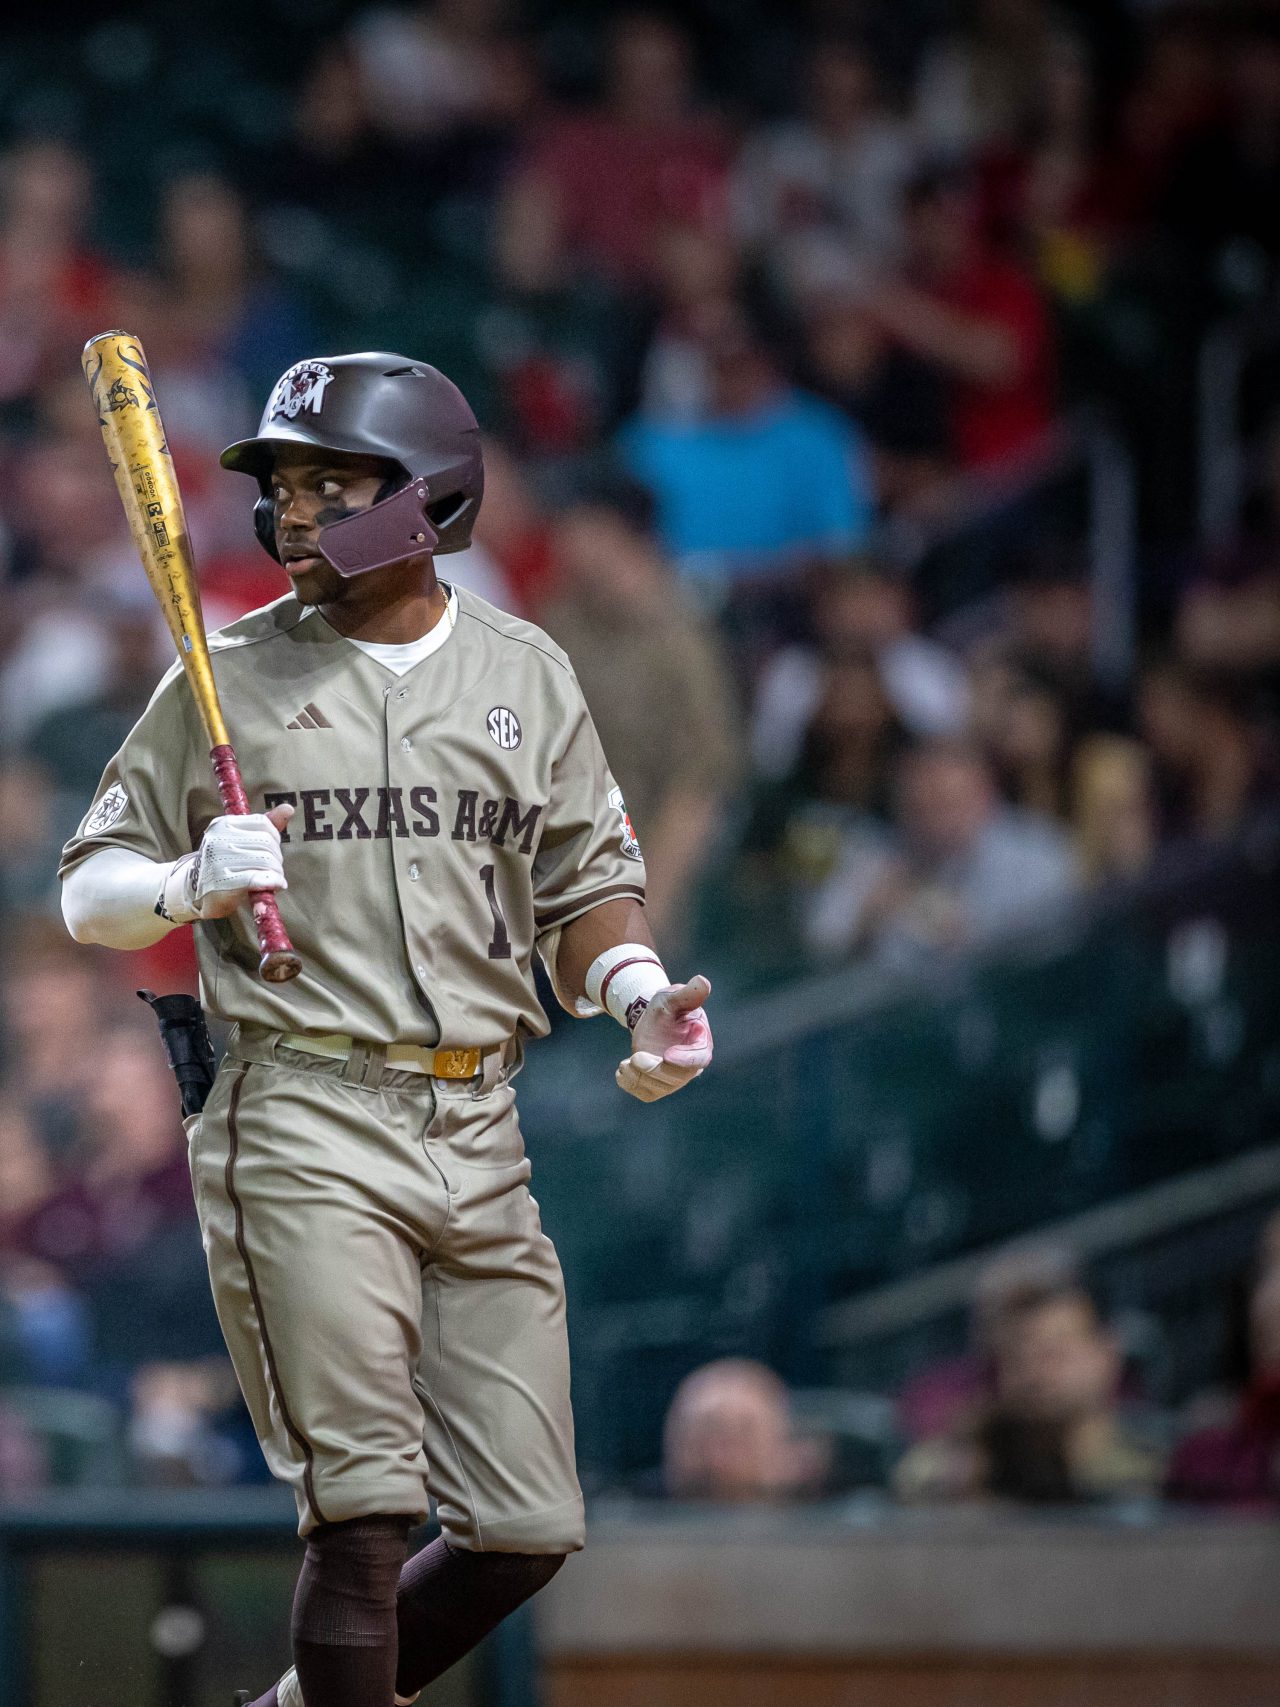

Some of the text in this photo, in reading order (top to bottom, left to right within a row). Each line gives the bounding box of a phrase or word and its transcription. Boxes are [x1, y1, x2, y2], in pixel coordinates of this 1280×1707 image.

[144, 471, 156, 498] VOODOO
[487, 707, 521, 750] SEC
[451, 789, 542, 855] A&M
[479, 864, 511, 959] 1
